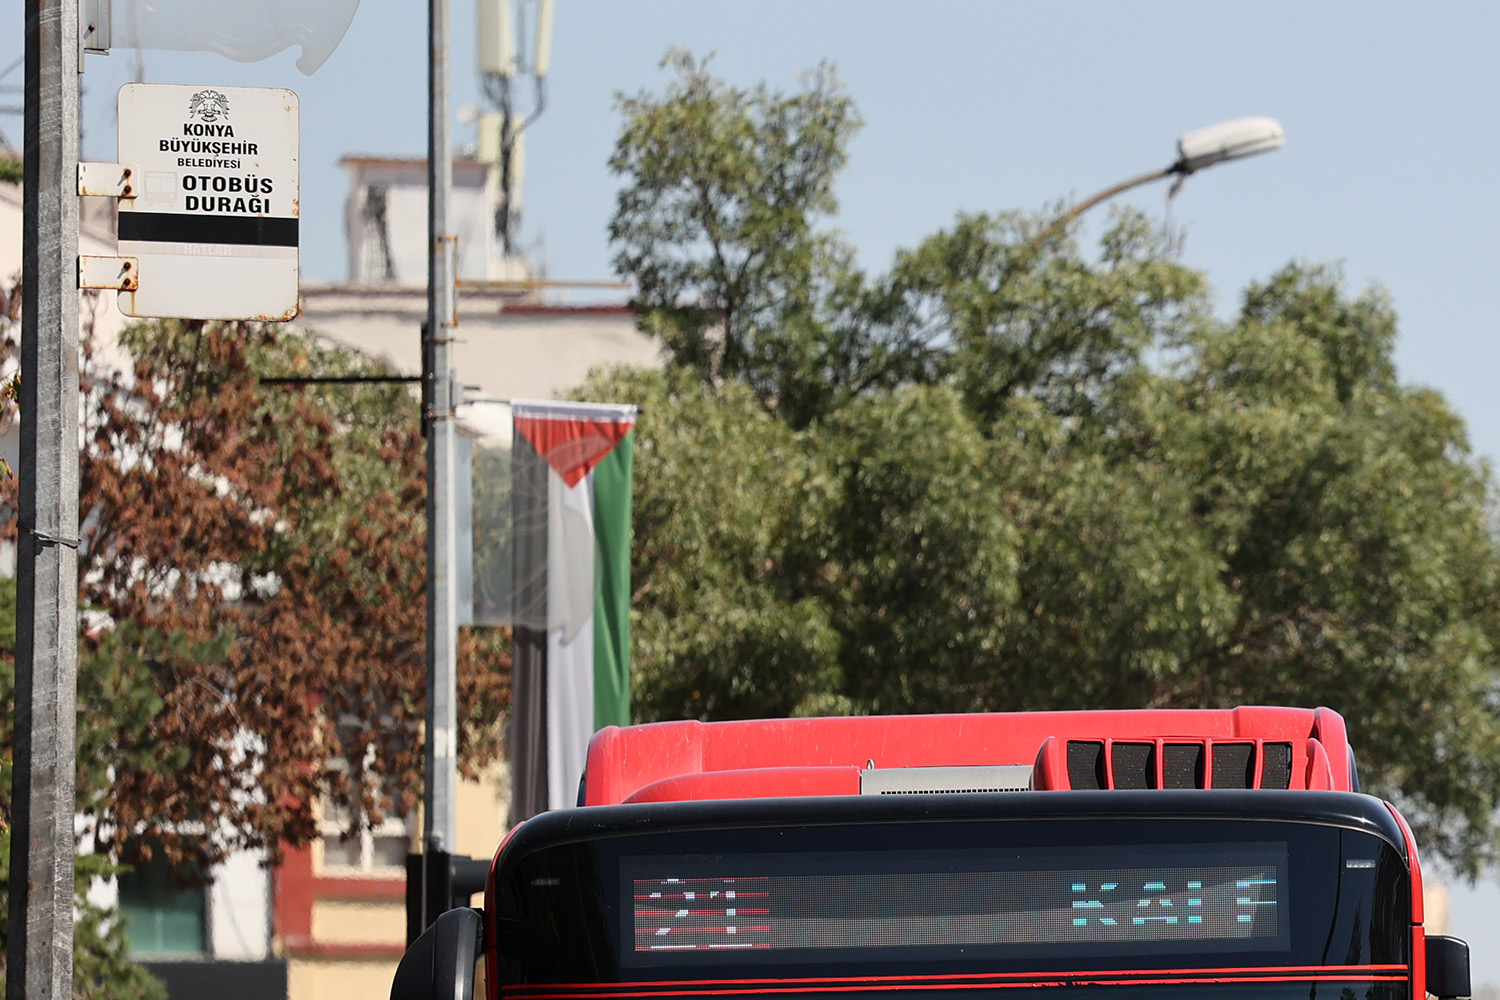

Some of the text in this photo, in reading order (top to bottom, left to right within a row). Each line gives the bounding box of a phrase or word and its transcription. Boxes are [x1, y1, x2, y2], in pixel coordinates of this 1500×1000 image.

[183, 123, 235, 138] KONYA
[159, 137, 258, 157] BÜYÜKŞEHİR
[177, 157, 241, 169] BELEDİYESİ
[182, 174, 273, 194] OTOBÜS
[185, 194, 270, 214] DURAĞI
